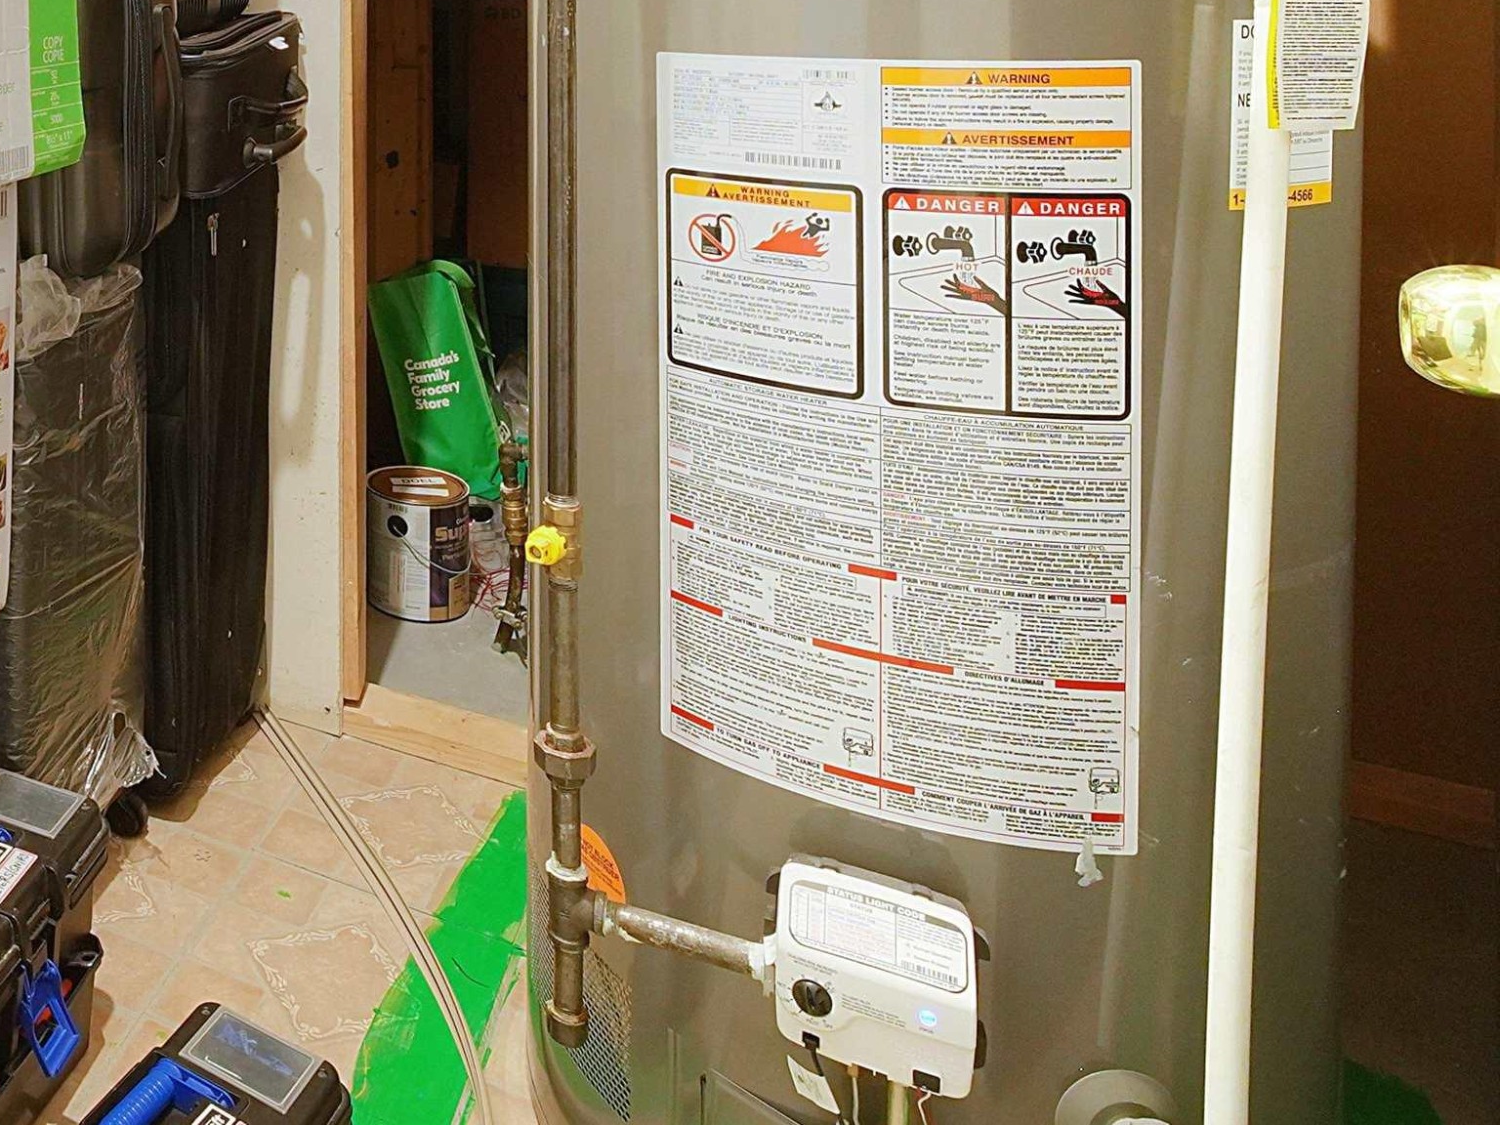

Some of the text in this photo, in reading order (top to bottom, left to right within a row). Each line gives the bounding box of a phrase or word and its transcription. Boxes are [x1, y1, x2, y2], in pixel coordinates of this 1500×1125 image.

[42, 35, 63, 50] COPY
[42, 50, 64, 64] COPIE
[988, 73, 1051, 84] WARNING
[962, 135, 1075, 147] AVERTISSEMENT
[740, 185, 790, 198] WARNING
[723, 193, 811, 208] AVERTISSEMENT
[916, 197, 1000, 213] DANGER
[1040, 202, 1120, 215] DANGER
[955, 262, 979, 271] HOT
[1068, 267, 1113, 276] CHAUDE
[738, 274, 778, 286] EXPLOSION
[404, 350, 460, 372] Canada's
[407, 369, 450, 386] Family
[411, 380, 460, 398] Grocery
[414, 397, 450, 411] Store
[827, 886, 864, 903] STATUS
[865, 895, 896, 913] LIGHT
